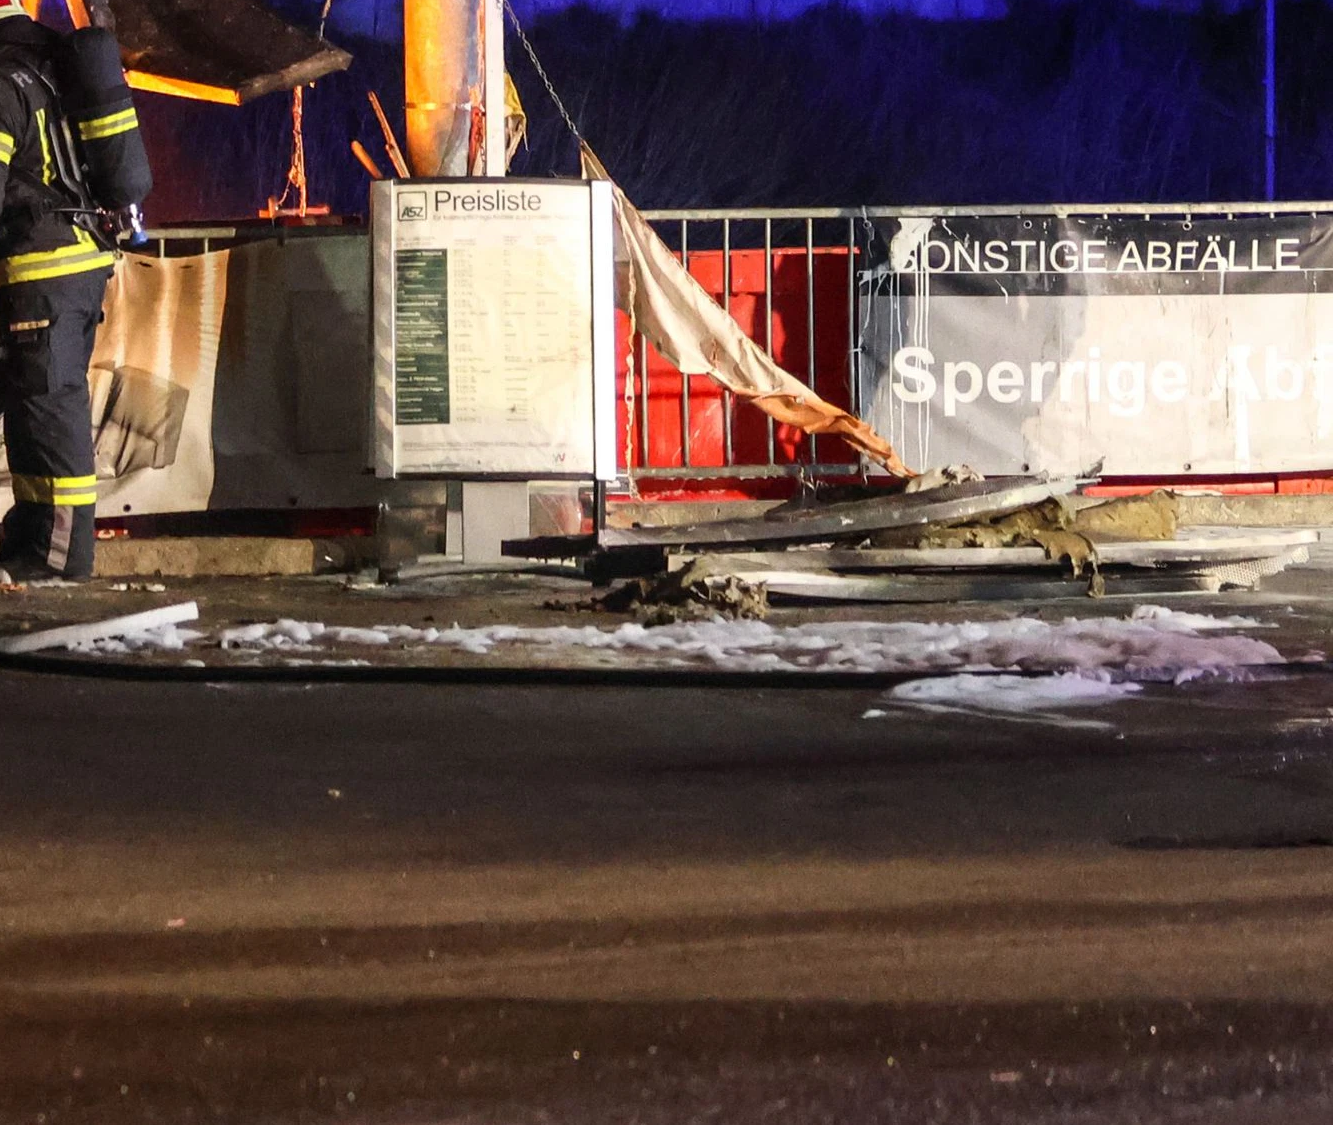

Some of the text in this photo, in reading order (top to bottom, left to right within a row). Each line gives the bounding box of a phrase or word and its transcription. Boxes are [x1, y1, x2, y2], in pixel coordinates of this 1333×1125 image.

[401, 206, 424, 218] ASZ
[435, 189, 542, 213] Preisliste
[1116, 237, 1301, 273] ABFÄLLE
[892, 346, 1190, 417] Sperrige
